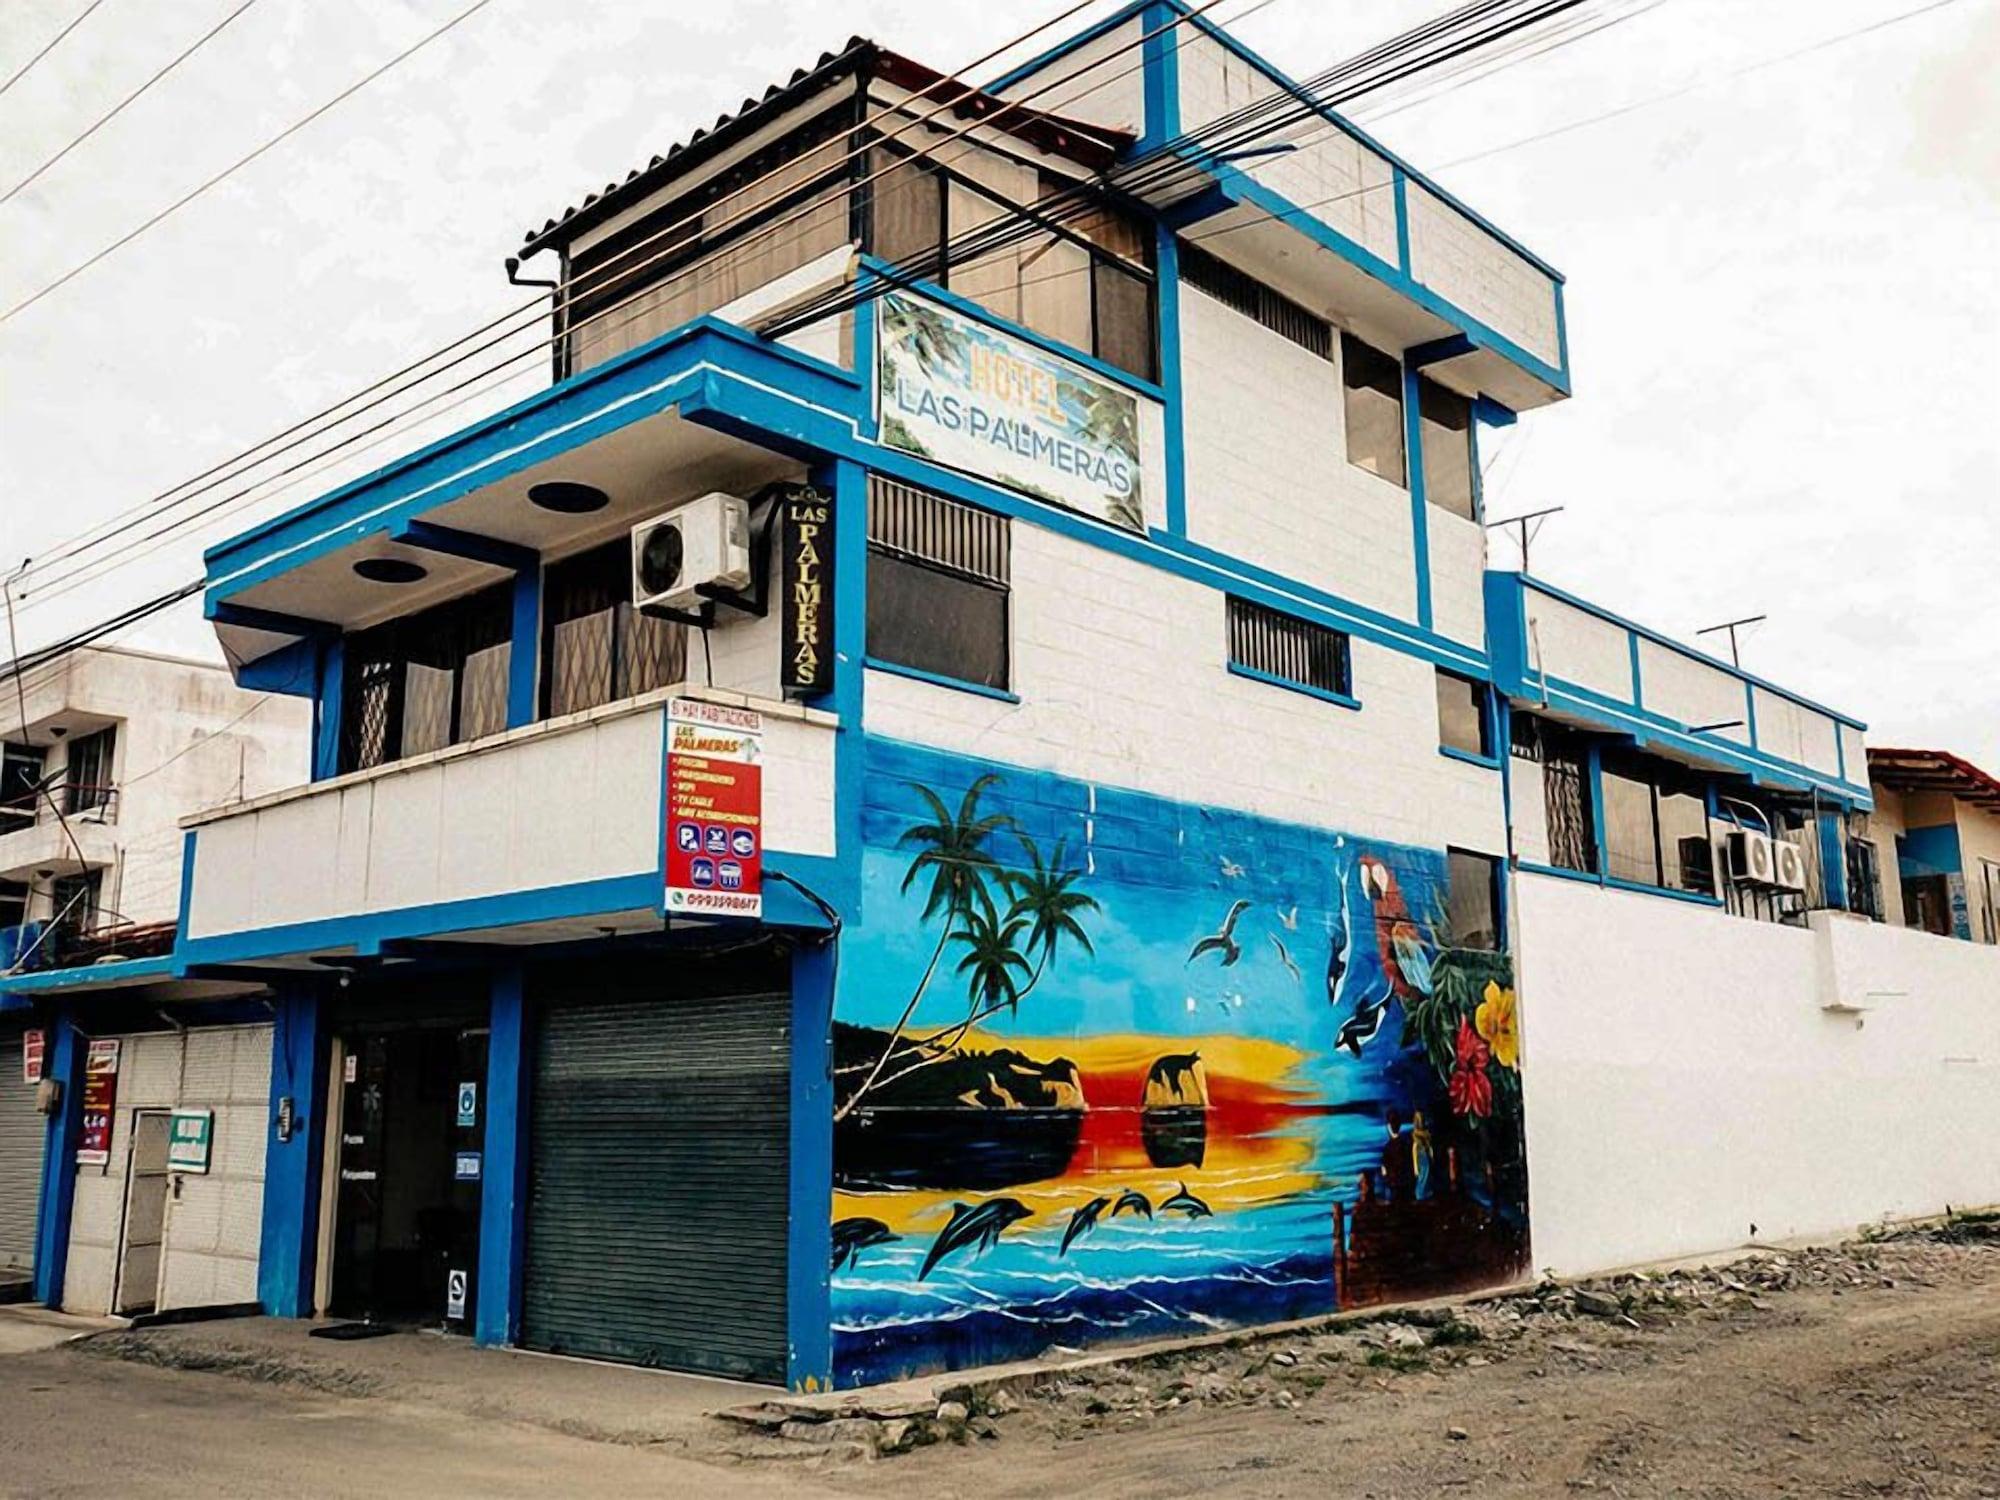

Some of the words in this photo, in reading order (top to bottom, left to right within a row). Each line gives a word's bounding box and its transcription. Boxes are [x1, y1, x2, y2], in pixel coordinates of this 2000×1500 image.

[970, 343, 1067, 424] HOTEL
[897, 377, 961, 430] LAS
[970, 405, 1131, 493] PALMERAS
[791, 506, 828, 523] LAS
[795, 524, 821, 685] PALMERAS
[673, 737, 739, 753] PALMERAS
[675, 726, 695, 737] LAS
